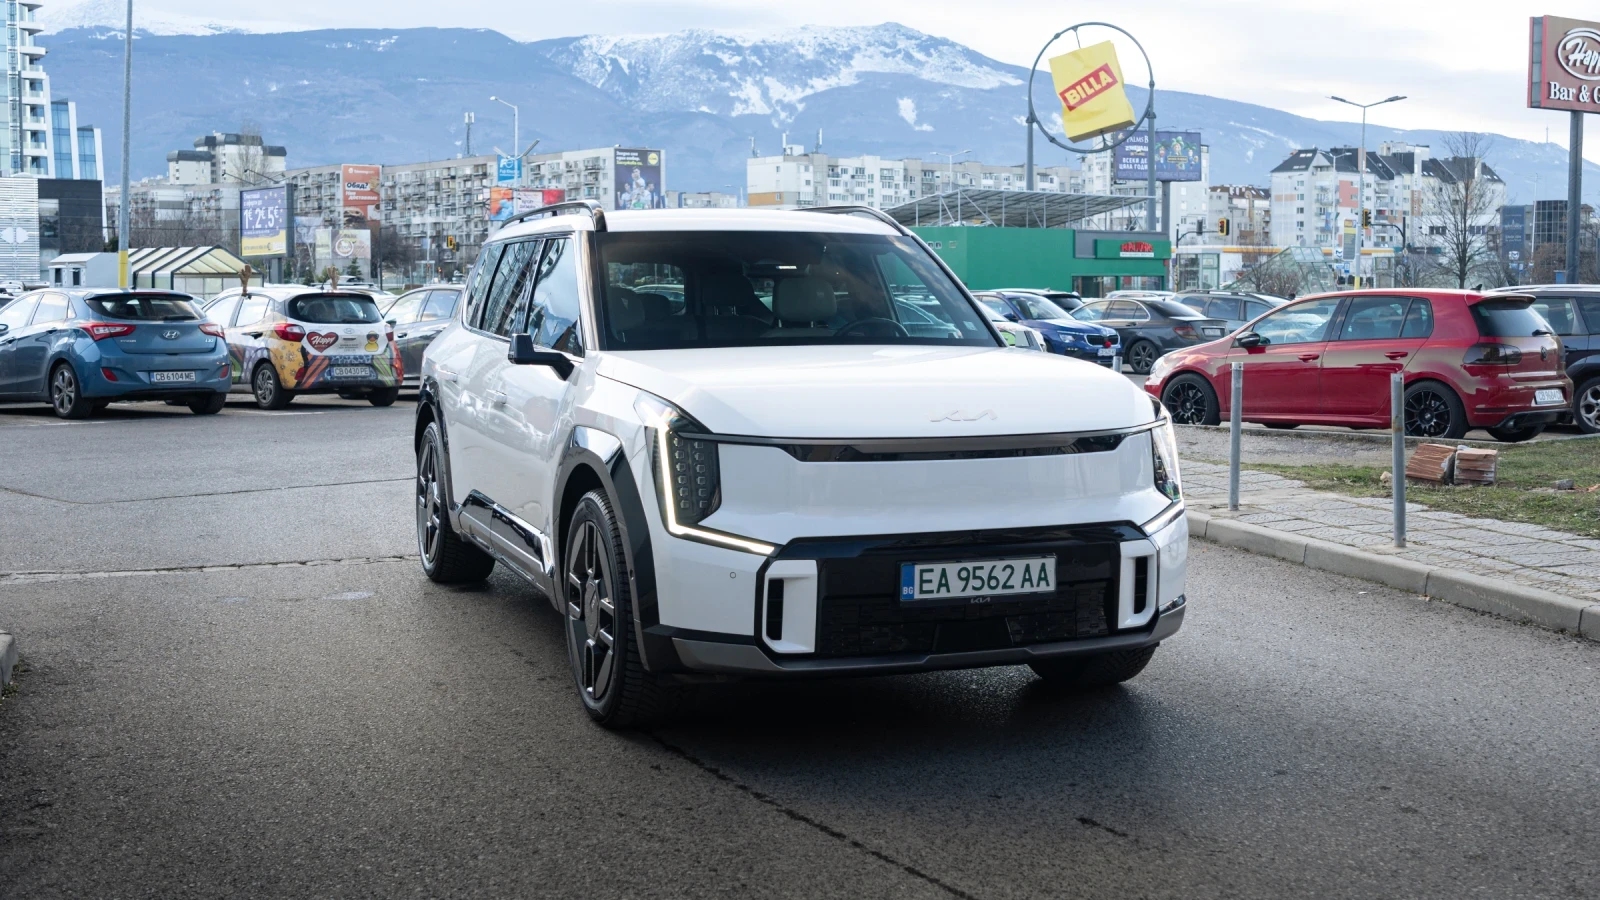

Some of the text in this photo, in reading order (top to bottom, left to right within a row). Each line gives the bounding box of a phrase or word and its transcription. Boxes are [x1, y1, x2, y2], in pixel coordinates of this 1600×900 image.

[1063, 70, 1114, 106] BILLA
[1549, 81, 1576, 101] Bar
[1579, 84, 1591, 103] &
[1140, 157, 1149, 165] ДЕ
[334, 367, 369, 375] CB 0430 PE
[155, 372, 194, 381] CB 6104 ME
[918, 562, 1050, 595] EA 9562 AA
[902, 586, 914, 595] BG
[970, 596, 991, 604] KIA
